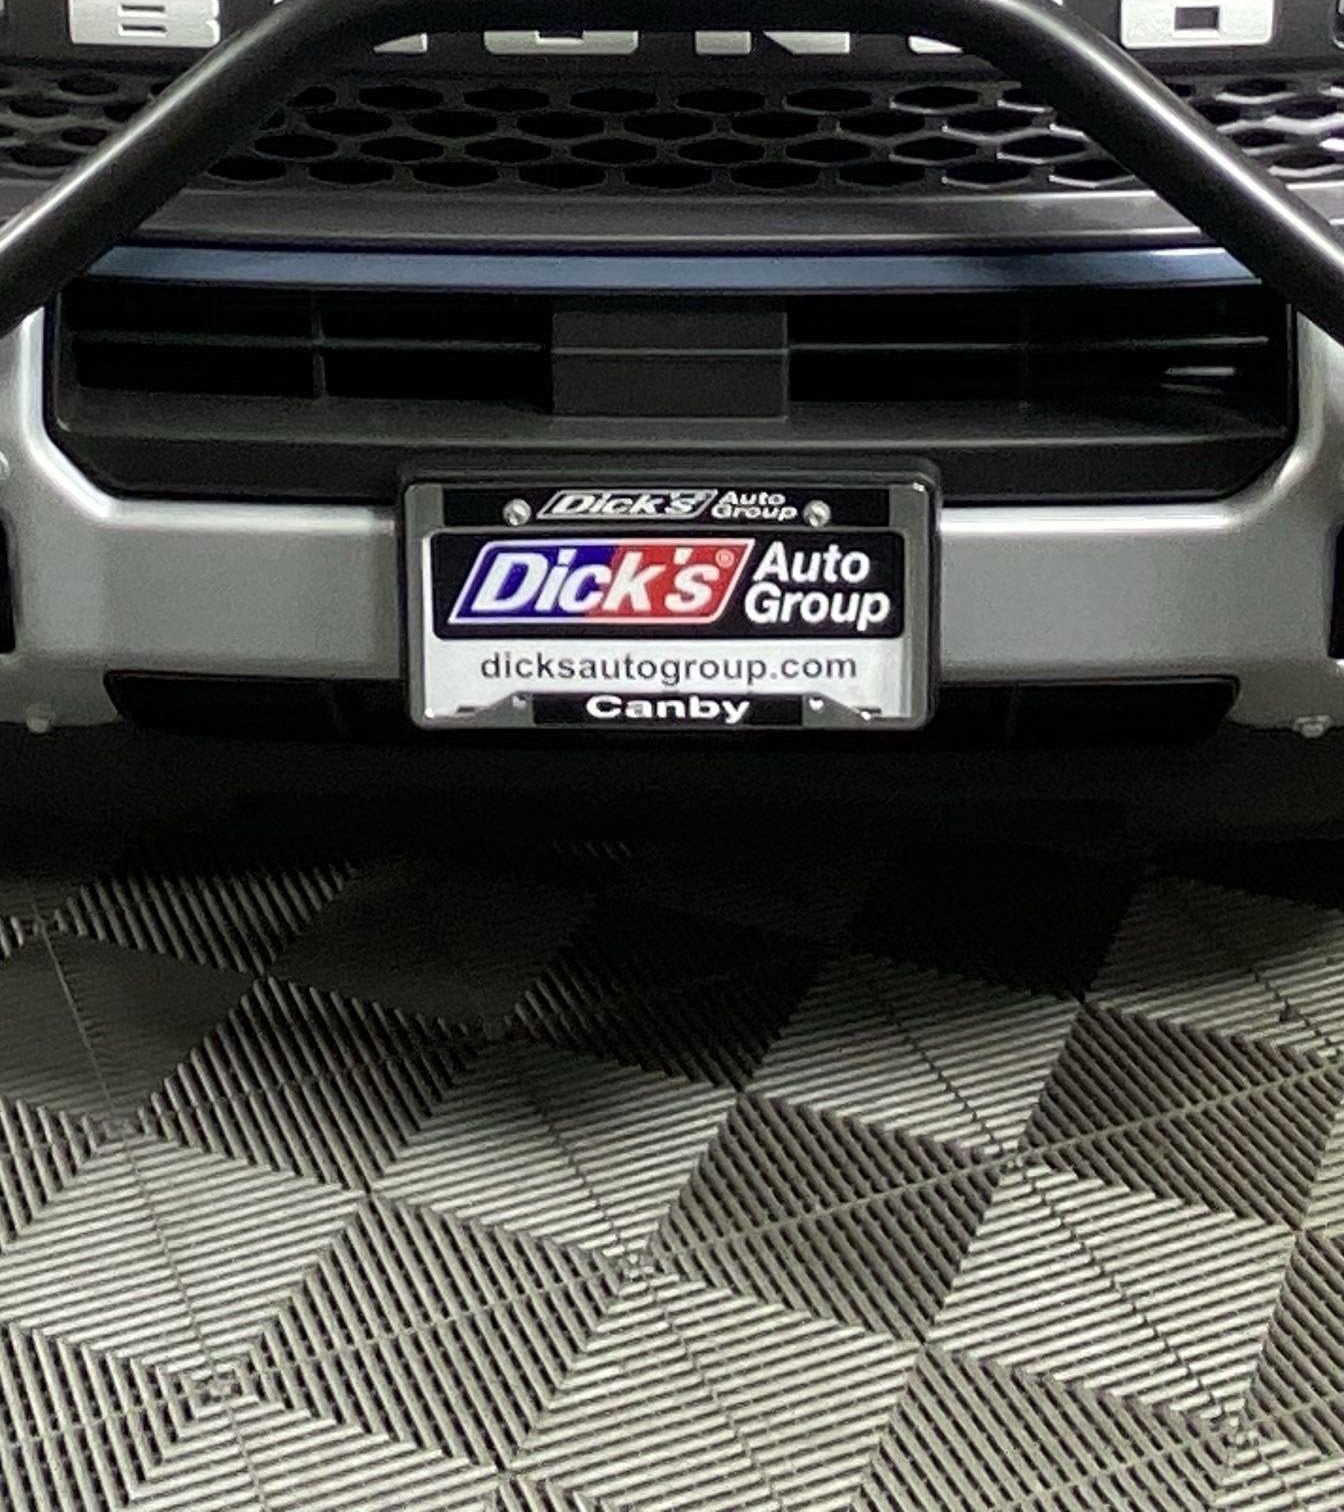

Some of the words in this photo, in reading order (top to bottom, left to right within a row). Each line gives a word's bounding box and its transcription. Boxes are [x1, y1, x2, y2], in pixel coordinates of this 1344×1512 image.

[711, 504, 798, 521] Group
[718, 491, 787, 506] Auto
[752, 541, 870, 583] Auto
[470, 548, 720, 612] Dick's
[744, 582, 891, 631] Group
[480, 652, 857, 686] dicksautogroup.com
[586, 694, 750, 724] Canby
